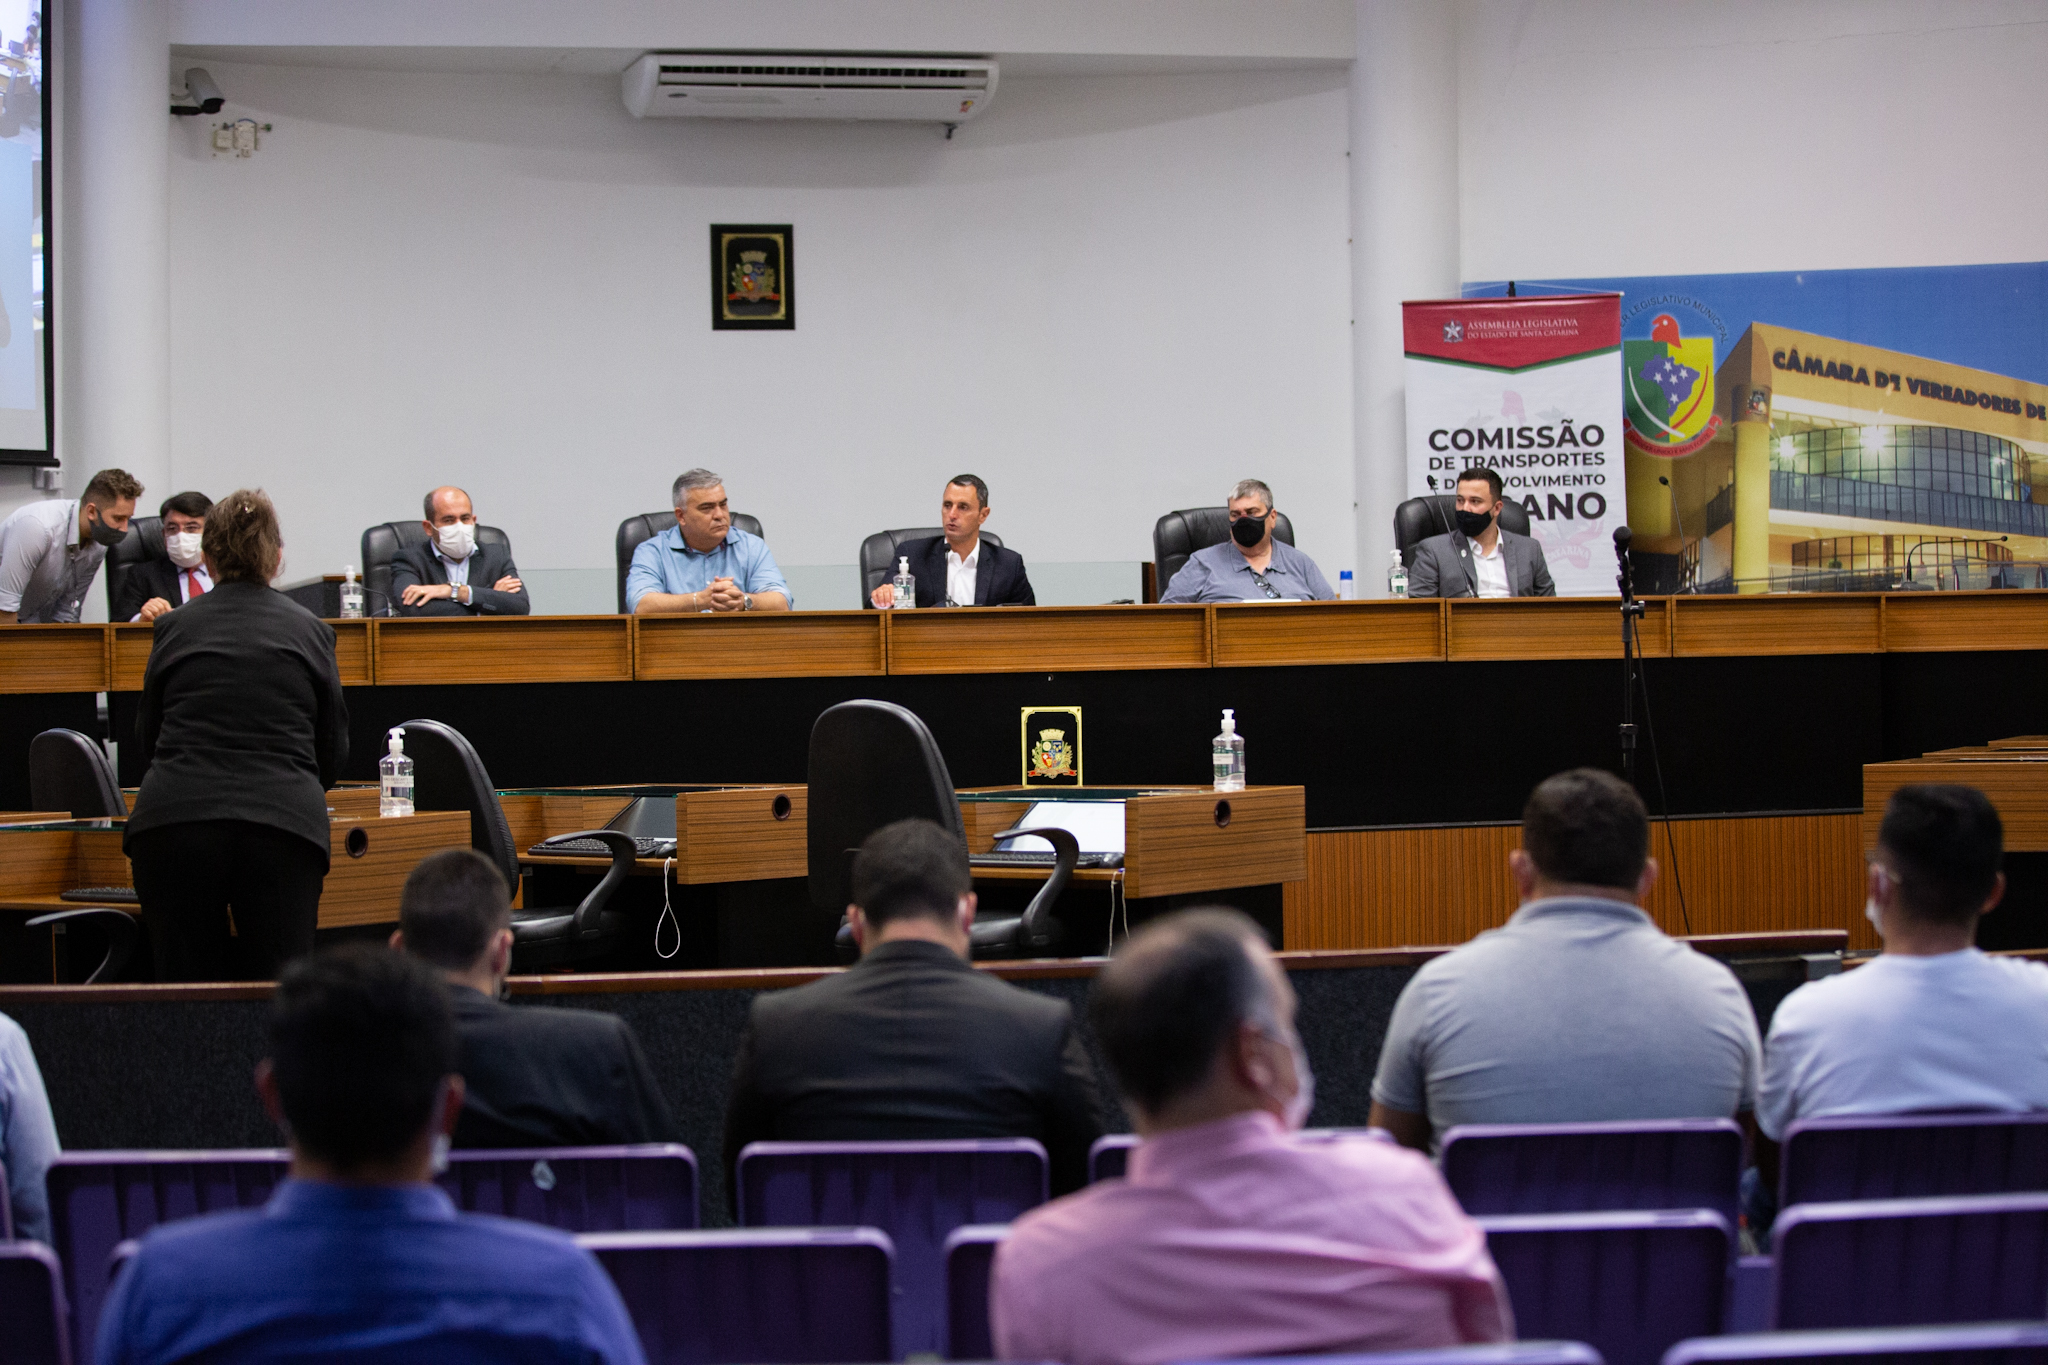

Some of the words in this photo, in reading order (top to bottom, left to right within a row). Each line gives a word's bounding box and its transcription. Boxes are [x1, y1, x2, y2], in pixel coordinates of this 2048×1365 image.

[1467, 319, 1521, 330] ASSEMBLEIA
[1523, 318, 1578, 328] LEGISLATIVA
[1628, 295, 1691, 317] LEGISLATIVO
[1692, 300, 1728, 345] MUNICIPAL
[1467, 331, 1479, 339] DO
[1480, 330, 1507, 338] ESTADO
[1509, 330, 1518, 338] DE
[1519, 329, 1542, 337] SANTA
[1543, 328, 1579, 336] CATARINA
[1772, 346, 1870, 385] CÂMARA
[1906, 376, 2021, 415] VEREADORES
[2026, 402, 2047, 420] DE
[1428, 418, 1605, 452] COMISSÃO
[1429, 456, 1455, 470] DE
[1461, 452, 1605, 469] TRANSPORTES
